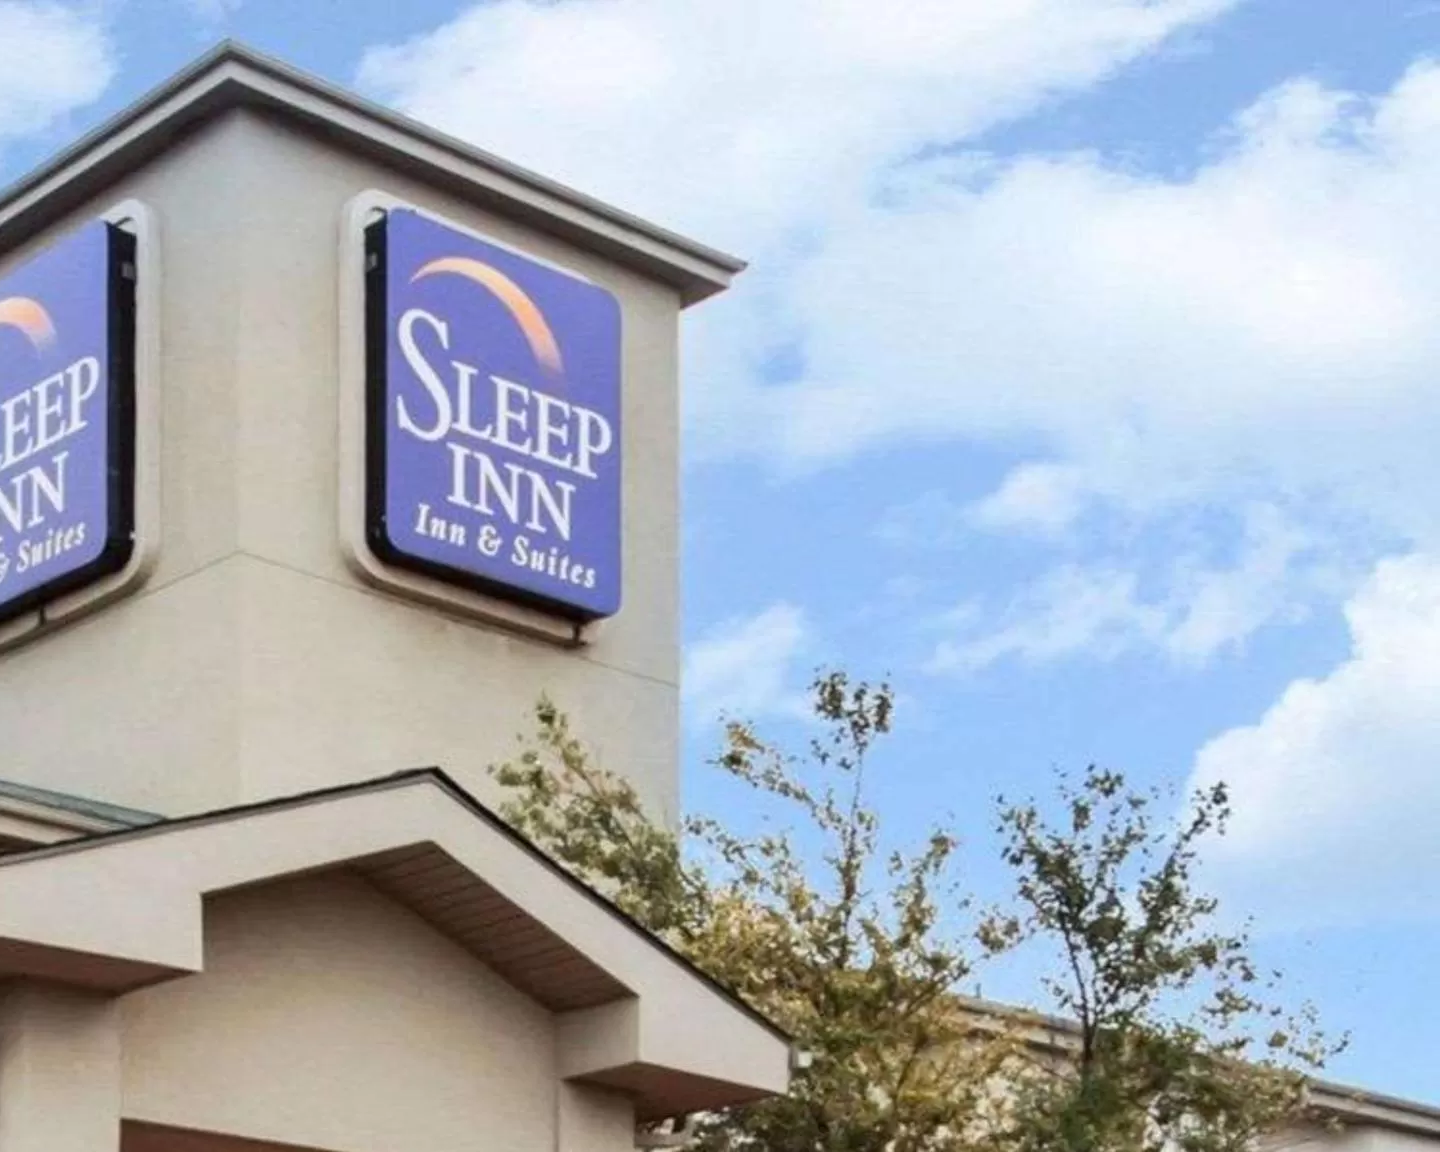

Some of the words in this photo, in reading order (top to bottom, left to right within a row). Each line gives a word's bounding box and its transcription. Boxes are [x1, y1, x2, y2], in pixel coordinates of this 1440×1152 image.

[396, 309, 612, 479] SLEEP
[447, 442, 575, 541] INN
[16, 521, 86, 574] Suites
[415, 503, 466, 546] Inn
[478, 526, 503, 556] &
[511, 535, 596, 589] Suites
